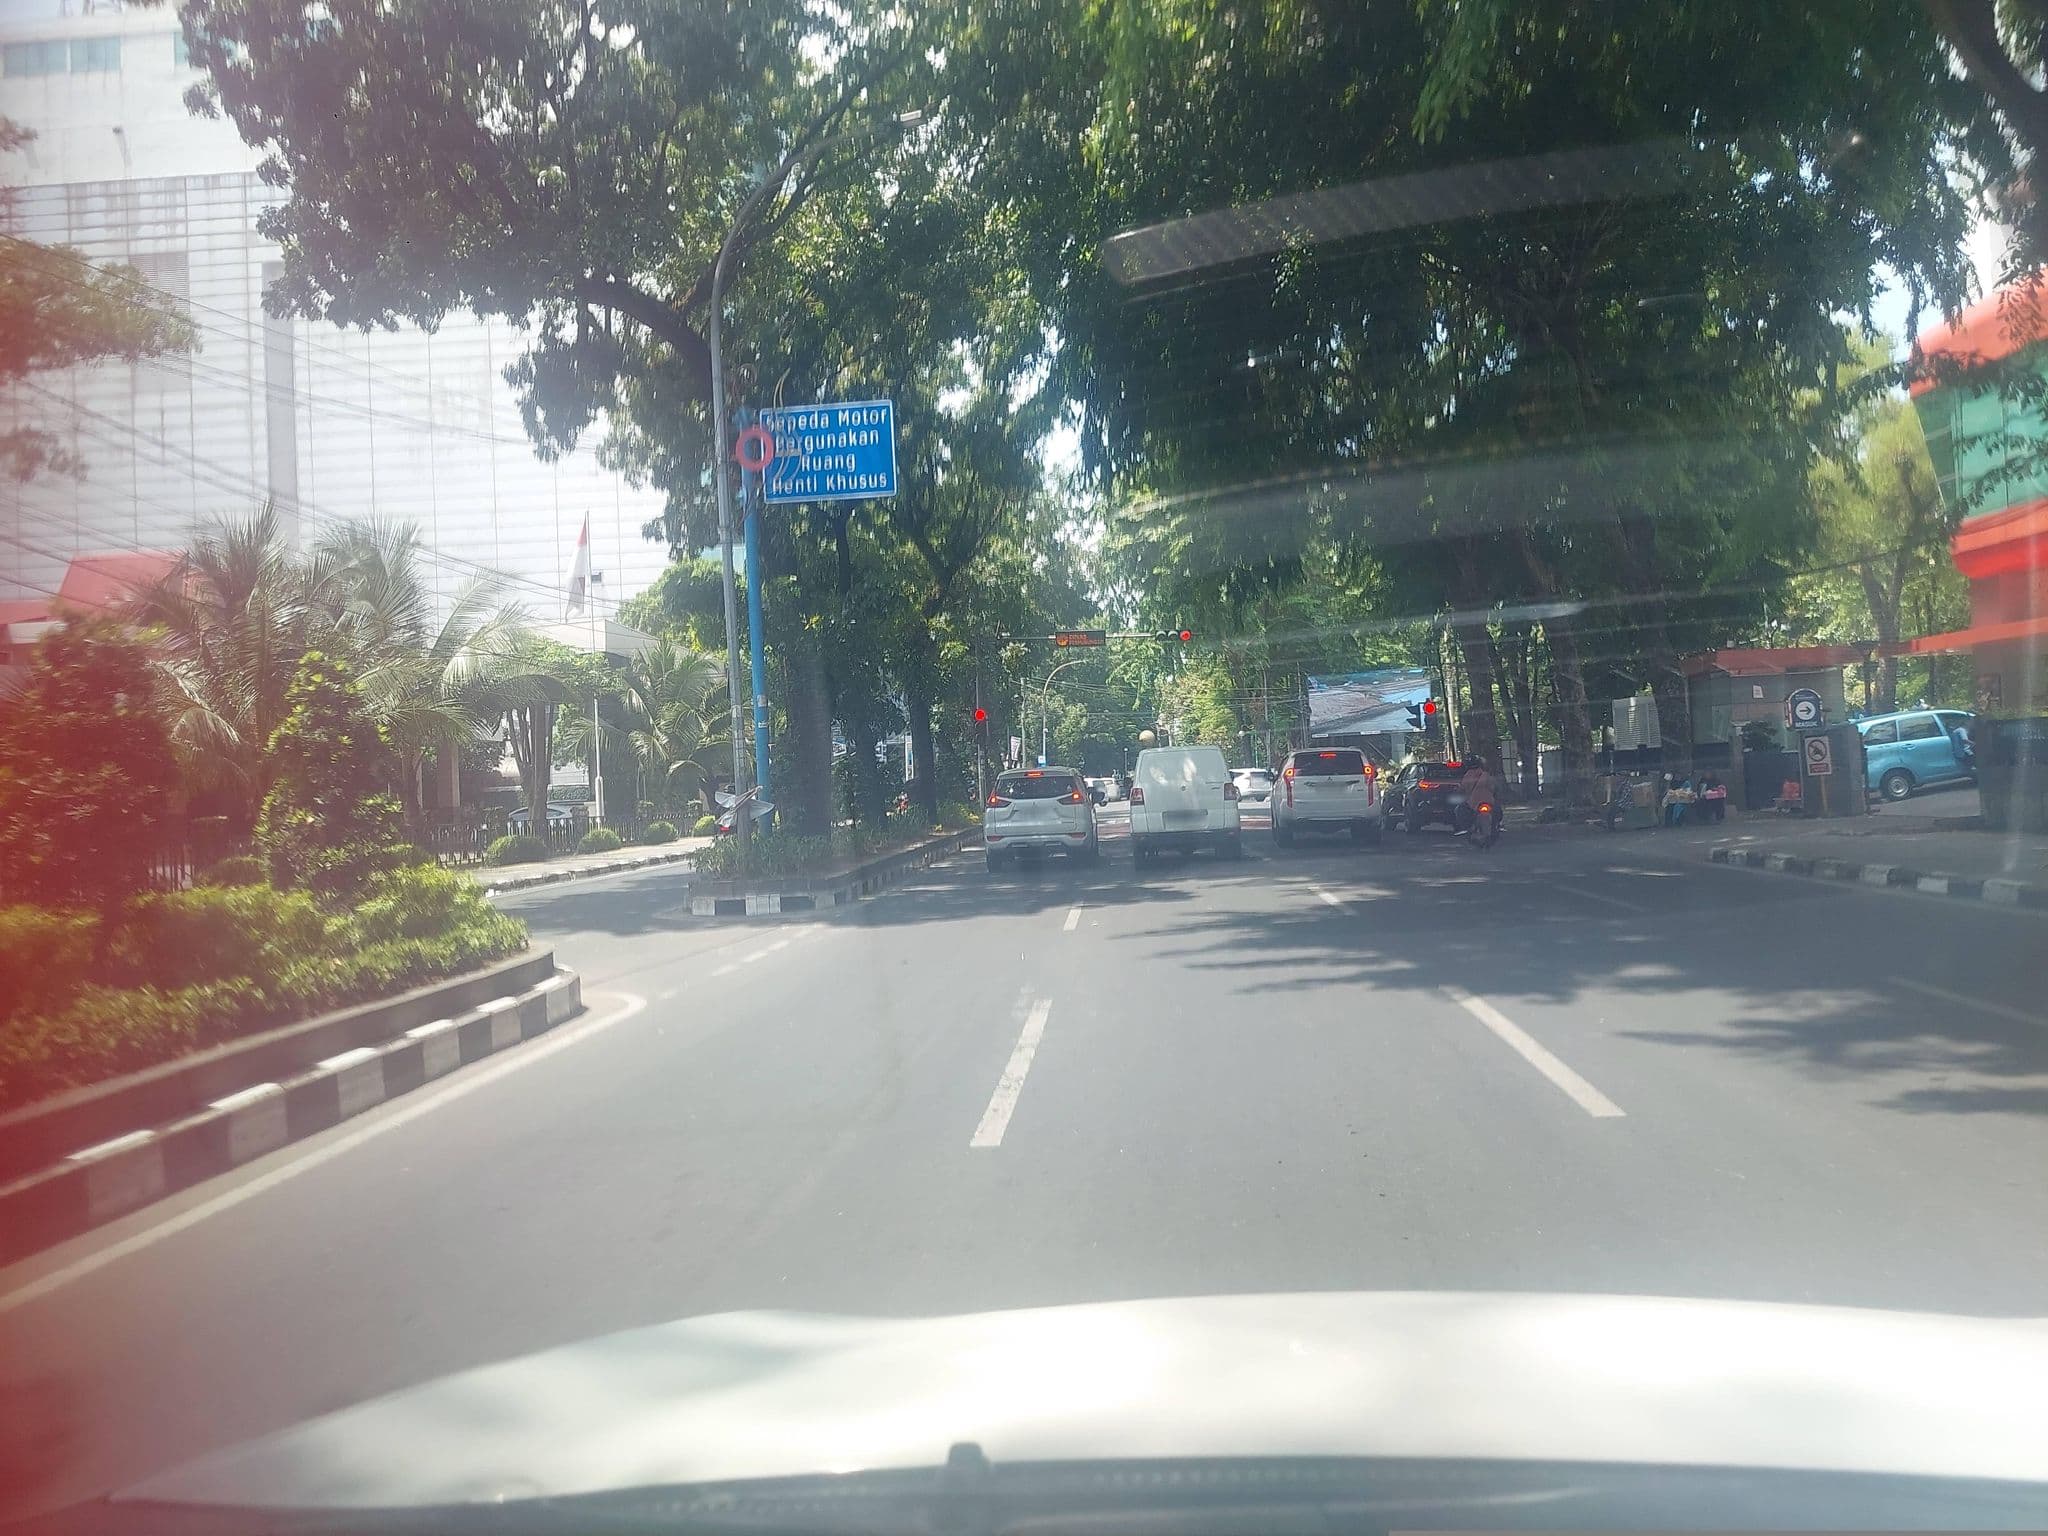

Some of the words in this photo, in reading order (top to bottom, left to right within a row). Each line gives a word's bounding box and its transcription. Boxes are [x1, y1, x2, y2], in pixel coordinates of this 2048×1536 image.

[766, 410, 829, 434] Sepeda
[838, 407, 887, 427] Motor
[801, 453, 856, 473] Ruang
[772, 476, 818, 496] Henti
[826, 472, 888, 492] Khusus
